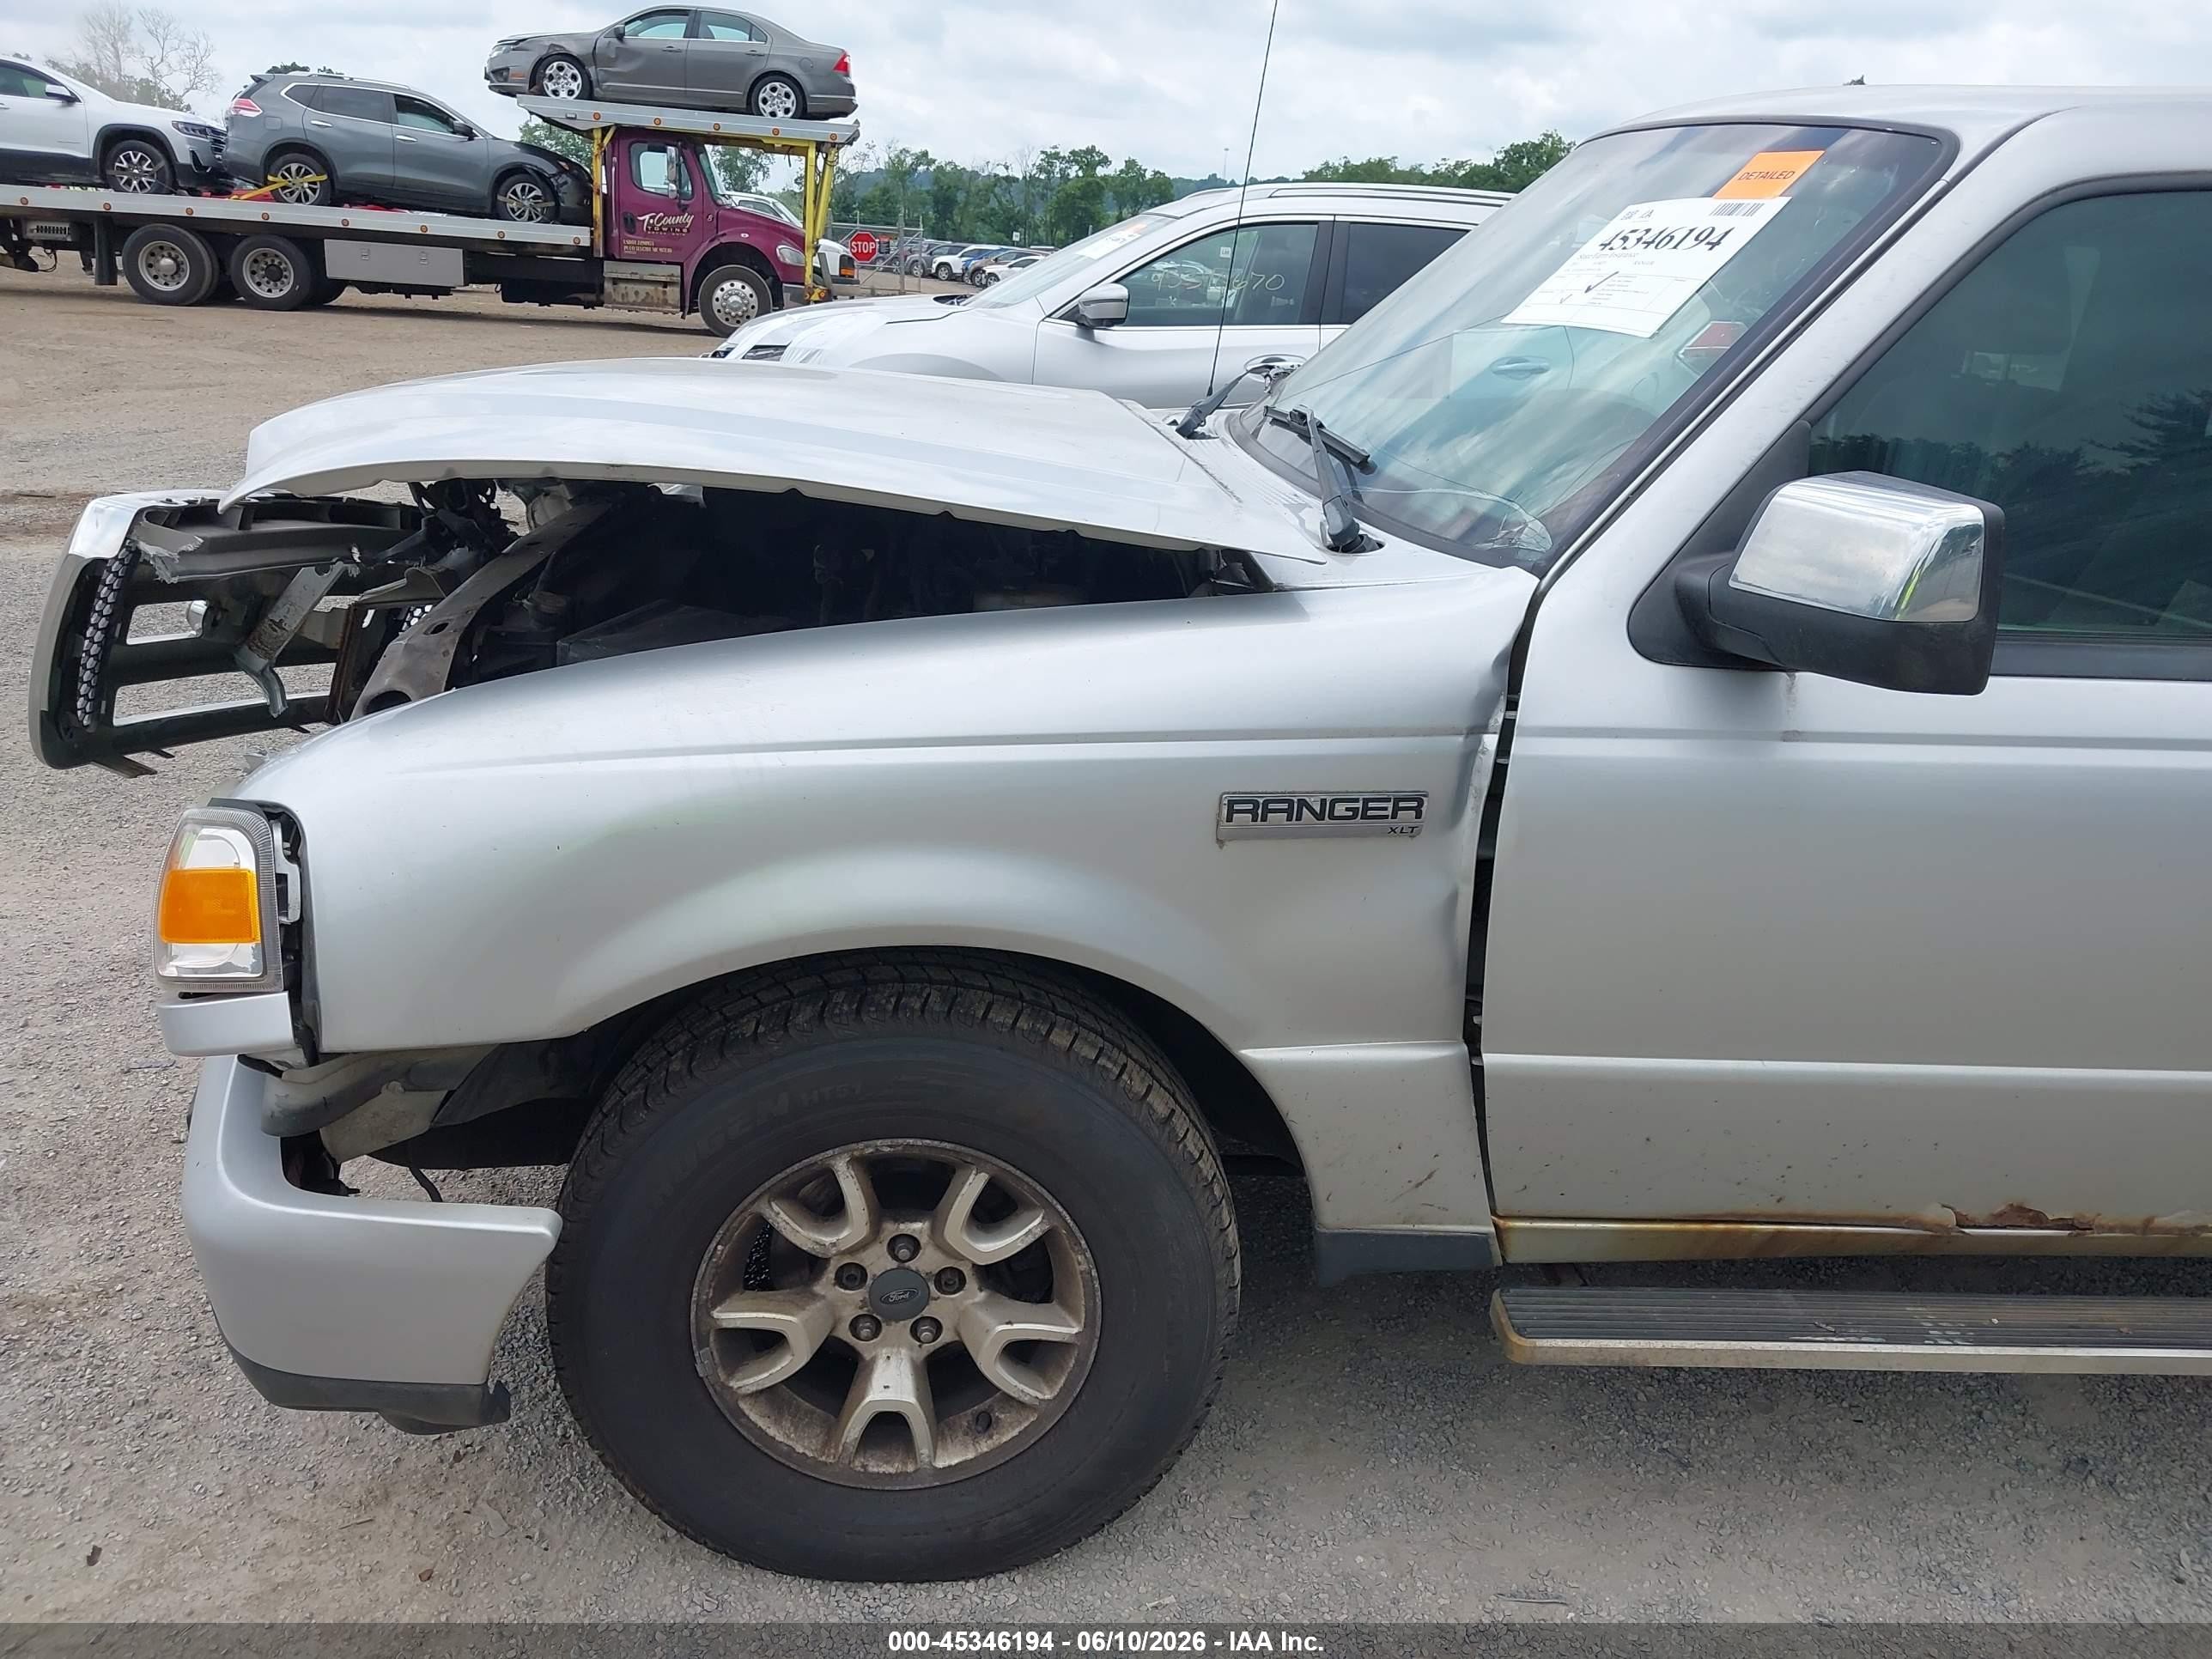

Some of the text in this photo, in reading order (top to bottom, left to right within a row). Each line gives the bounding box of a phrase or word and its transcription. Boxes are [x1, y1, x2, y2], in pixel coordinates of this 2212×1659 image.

[1737, 171, 1796, 181] DETAILED
[1598, 226, 1735, 252] 45346194
[851, 241, 876, 253] STOP
[1224, 797, 1425, 823] RANGER
[1387, 825, 1419, 835] XLT
[888, 1291, 910, 1303] Ford
